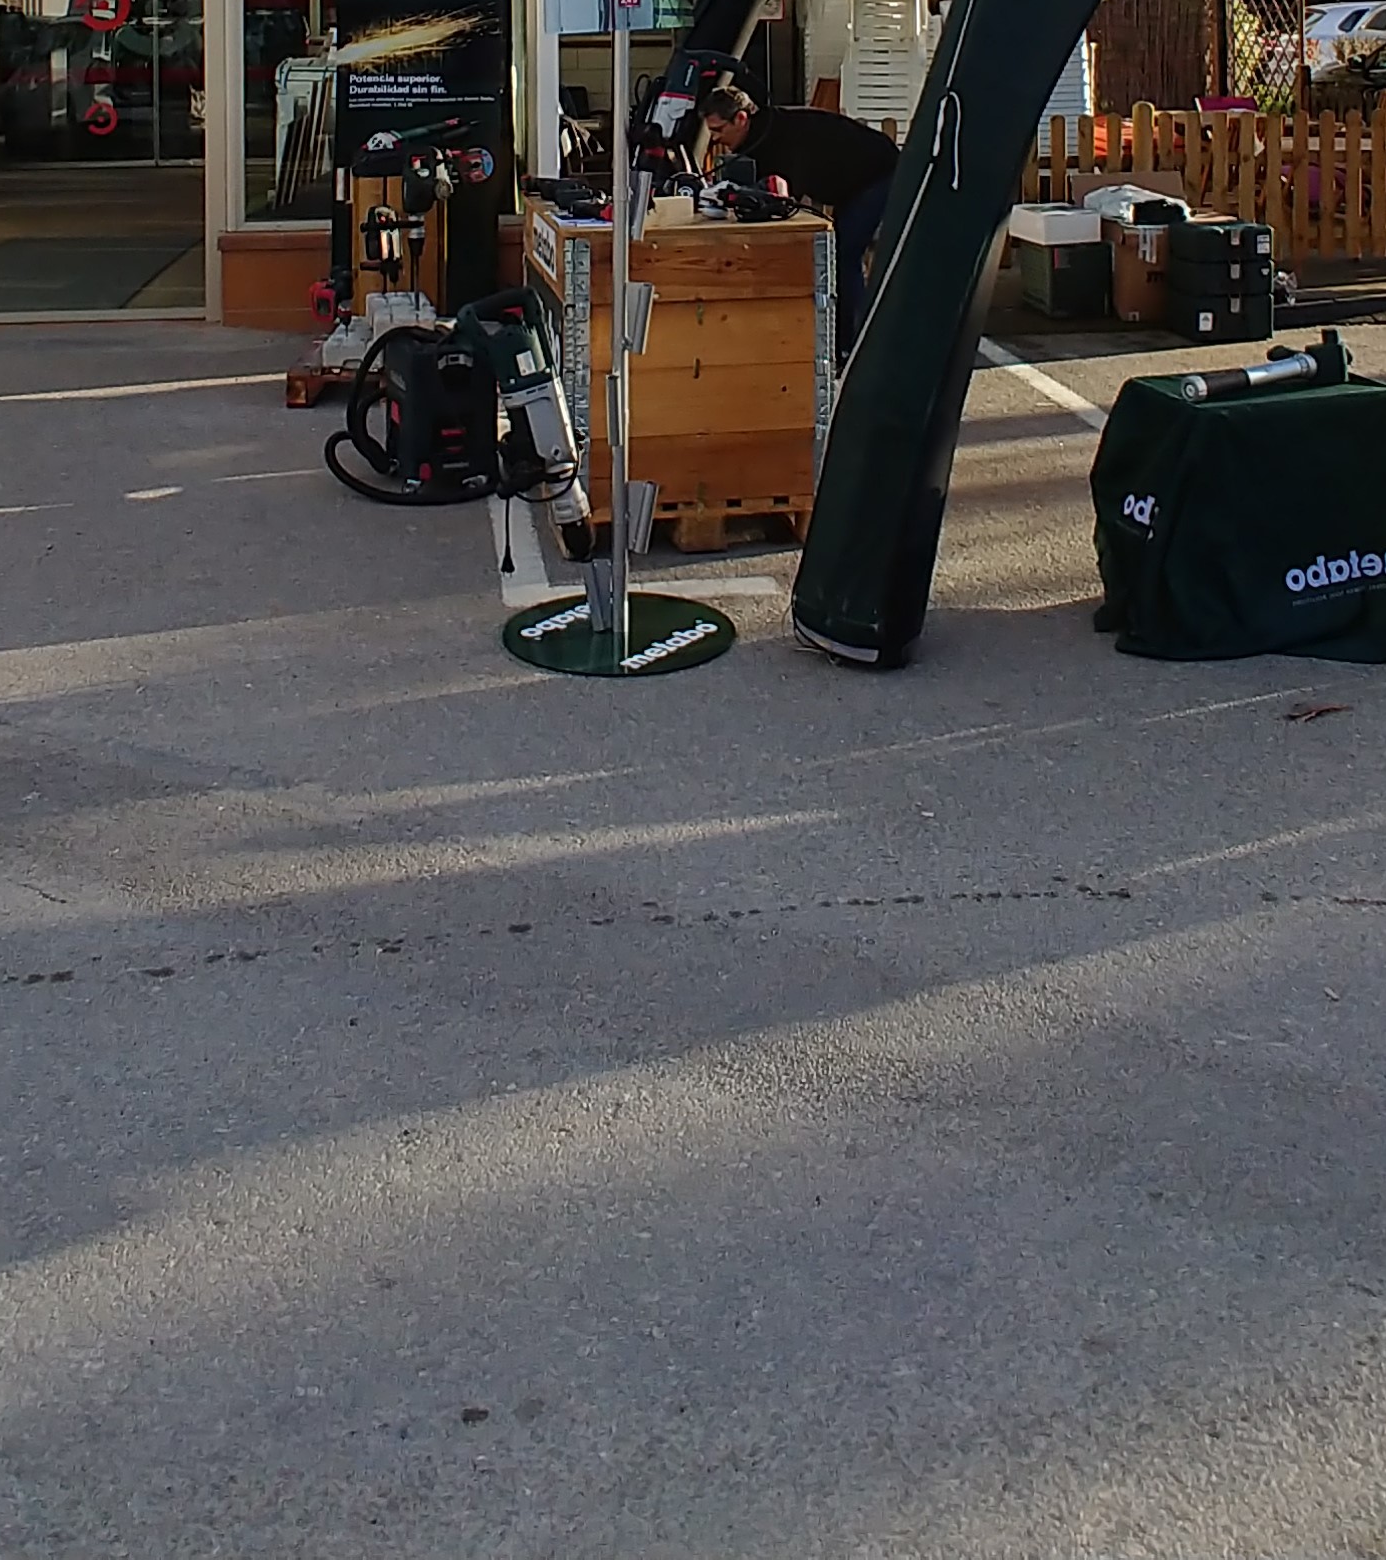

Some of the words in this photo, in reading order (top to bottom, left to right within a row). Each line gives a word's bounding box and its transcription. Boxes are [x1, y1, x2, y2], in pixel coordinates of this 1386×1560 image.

[349, 74, 394, 83] Potencia
[397, 74, 443, 85] superior.
[349, 85, 410, 94] Durabilidad
[412, 85, 428, 94] sin
[430, 85, 447, 94] fin.
[620, 622, 719, 670] metabo
